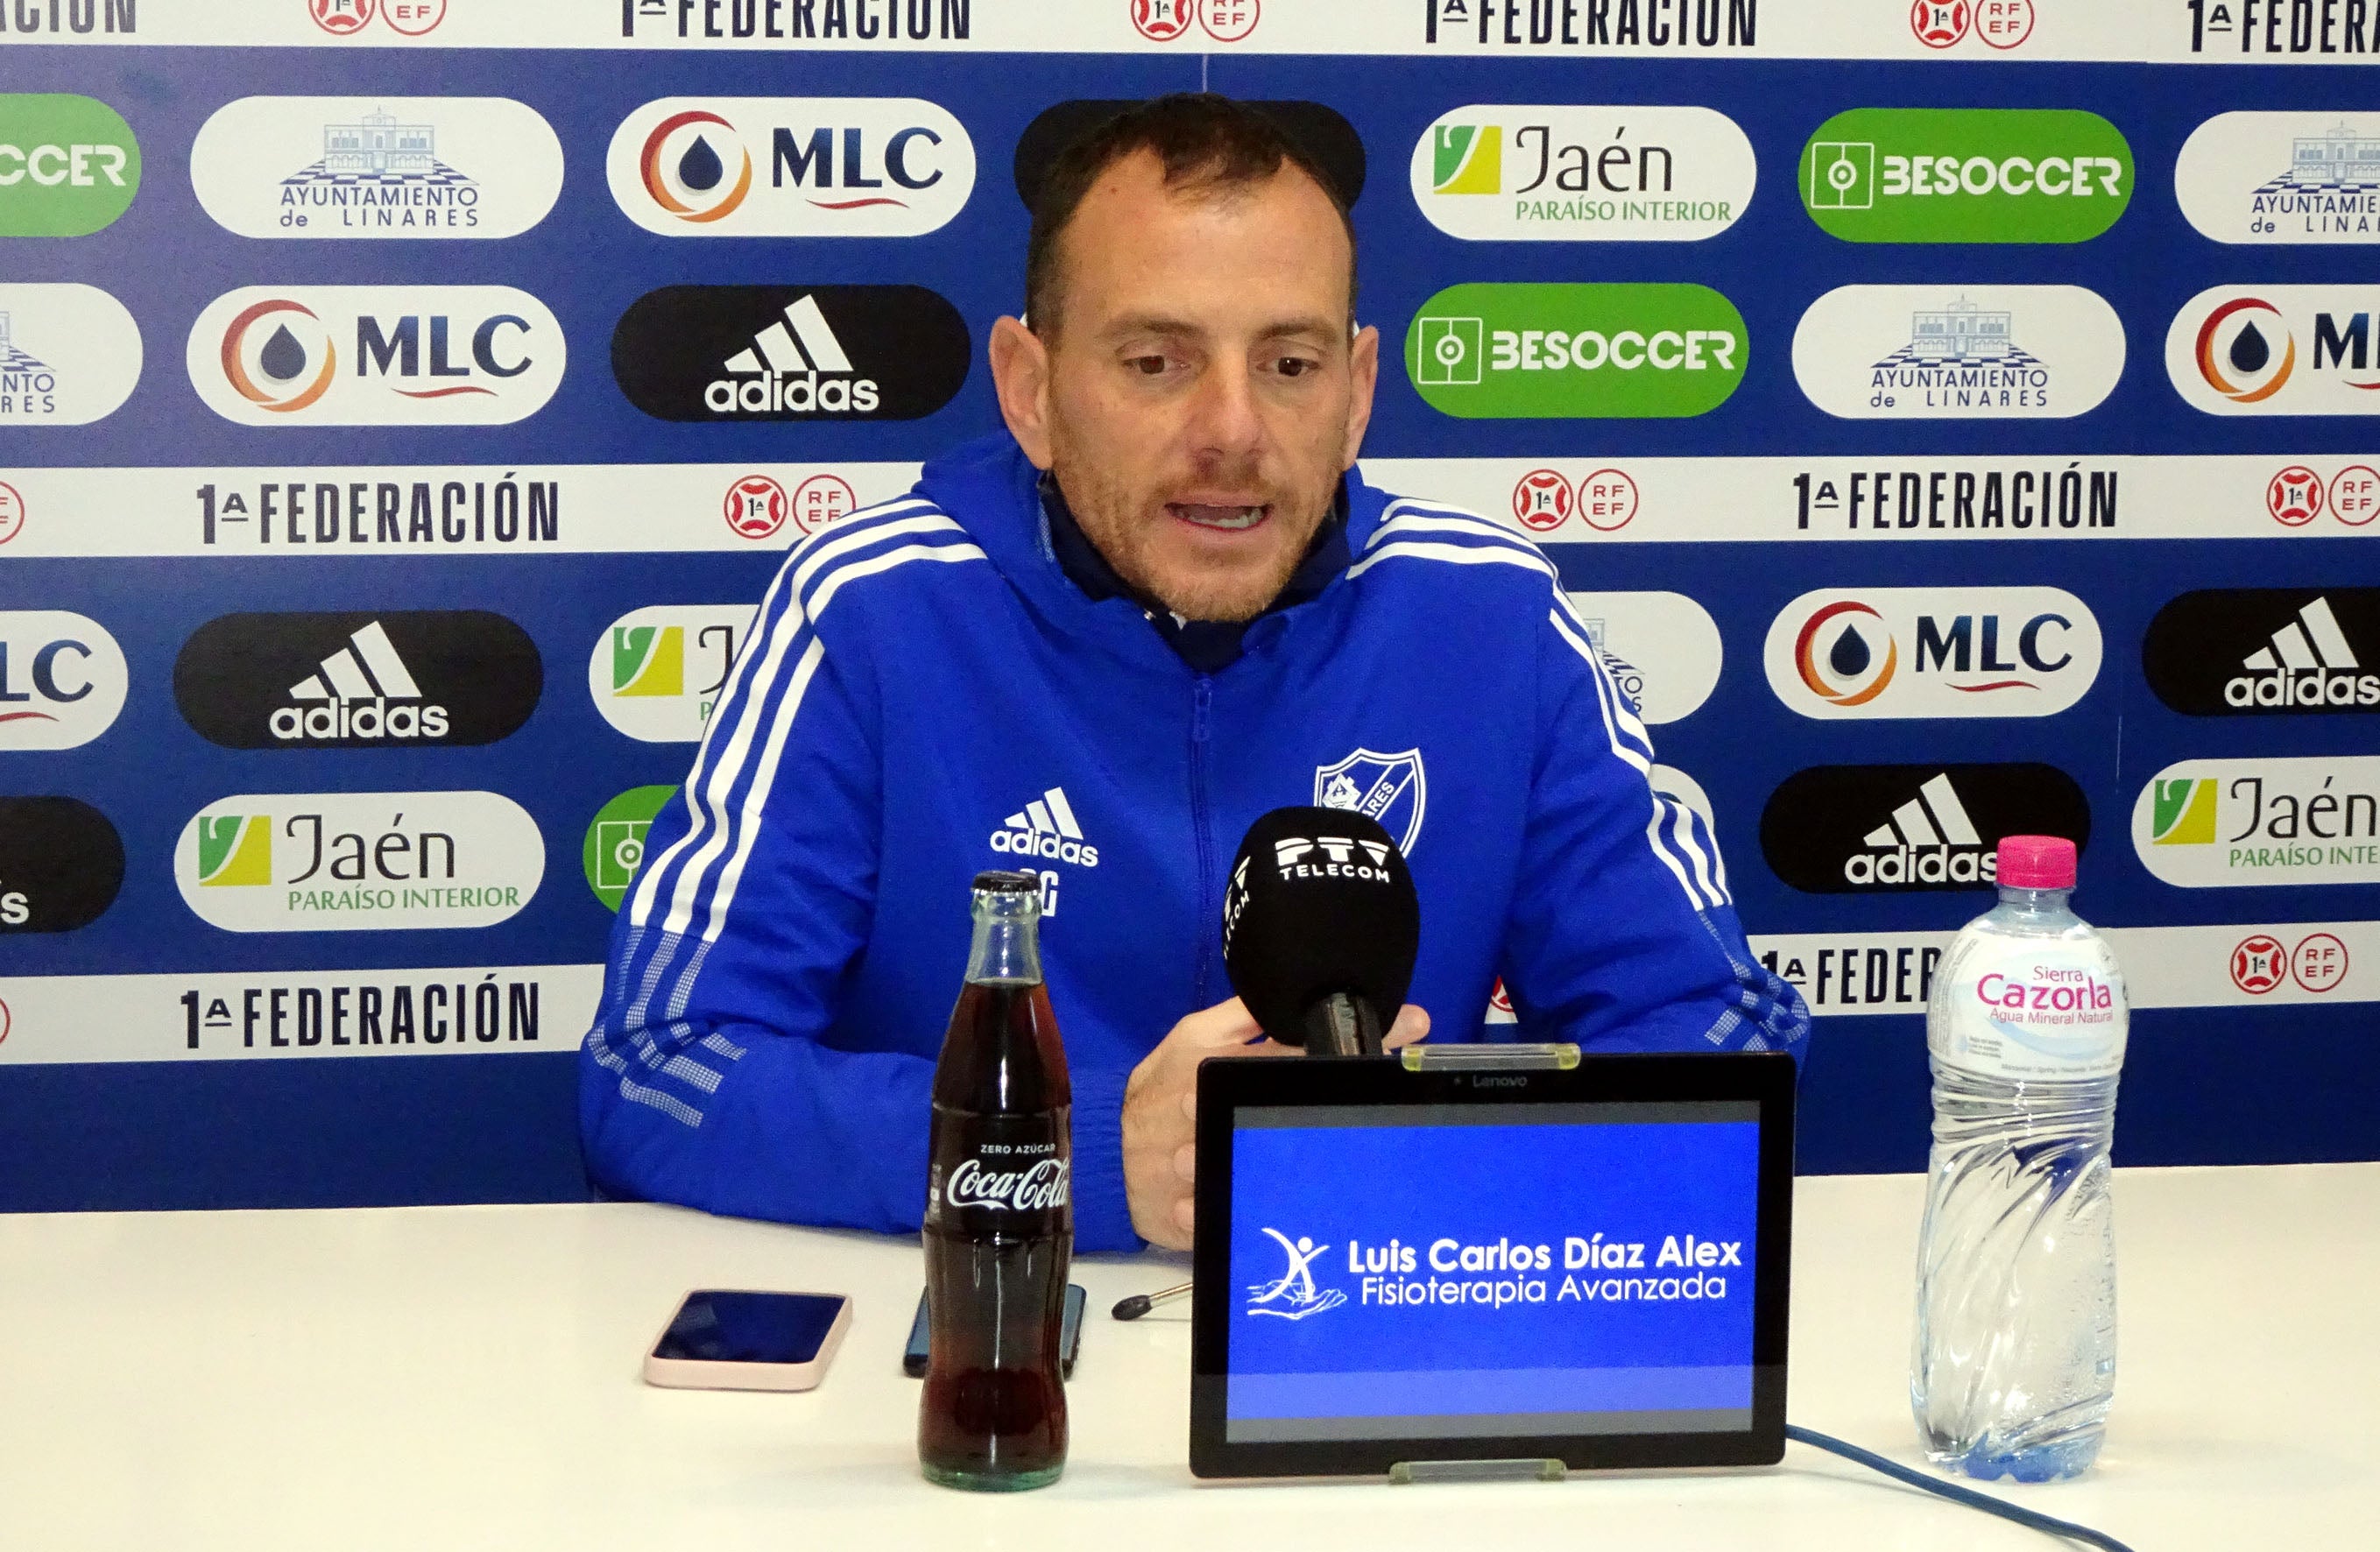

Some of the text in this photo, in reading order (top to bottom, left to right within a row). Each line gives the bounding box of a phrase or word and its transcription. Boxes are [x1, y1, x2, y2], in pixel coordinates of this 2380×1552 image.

[772, 126, 943, 189] MLC
[1515, 126, 1672, 194] Jaén
[1883, 156, 2122, 197] BESOCCER
[280, 187, 478, 207] AYUNTAMIENTO
[1515, 196, 1732, 221] PARAÍSO INTERIOR
[279, 208, 478, 228] de LINARES
[2250, 215, 2380, 233] de LINA
[357, 314, 533, 378] MLC
[1492, 329, 1735, 370] BESOCCER
[704, 370, 879, 413] adidas
[1870, 389, 2047, 408] de LINARES
[1871, 369, 2048, 389] AYUNTAMIENTO
[260, 472, 559, 544] FEDERACIÓN
[1850, 462, 2118, 529] FEDERACIÓN
[1916, 613, 2073, 674] MLC
[2224, 667, 2380, 707] adidas
[271, 697, 449, 739] adidas
[2229, 776, 2377, 843] Jaén
[286, 813, 455, 885] Jaén
[990, 827, 1099, 867] adidas
[1275, 836, 1390, 866] PTV
[1845, 843, 1998, 884] adidas
[2229, 842, 2323, 867] PARAÍSO
[1279, 864, 1391, 884] TELECOM
[288, 884, 520, 911] PARAÍSO INTERIOR
[1976, 973, 2113, 1011] Cazorla
[2033, 965, 2084, 982] Sierra
[244, 973, 540, 1048] FEDERACIÓN
[1989, 1007, 2114, 1025] Agua Mineral Natural
[1472, 1074, 1528, 1088] Lenovo
[980, 1143, 1056, 1154] ZERO AZÚCAR
[947, 1156, 1070, 1210] Coca-Cola
[1349, 1232, 1742, 1273] Luis Carlos Díaz Alex
[1362, 1271, 1727, 1309] Fisioterapia Avanzada
